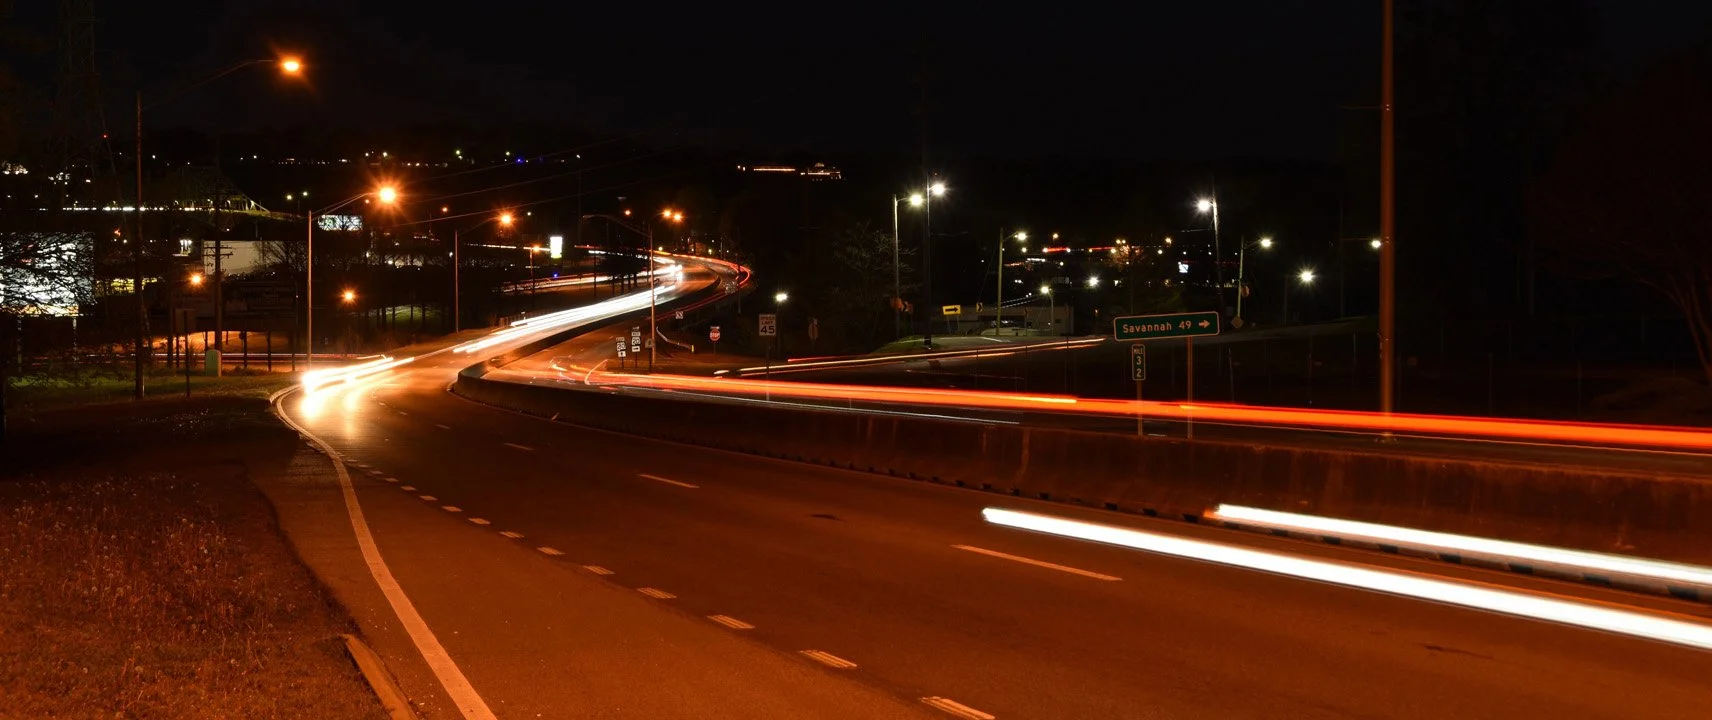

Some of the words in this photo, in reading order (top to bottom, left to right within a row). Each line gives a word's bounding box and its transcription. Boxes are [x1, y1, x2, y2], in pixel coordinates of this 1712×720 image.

[760, 325, 775, 334] 45
[1123, 321, 1172, 333] Savannah
[1179, 320, 1192, 330] 49
